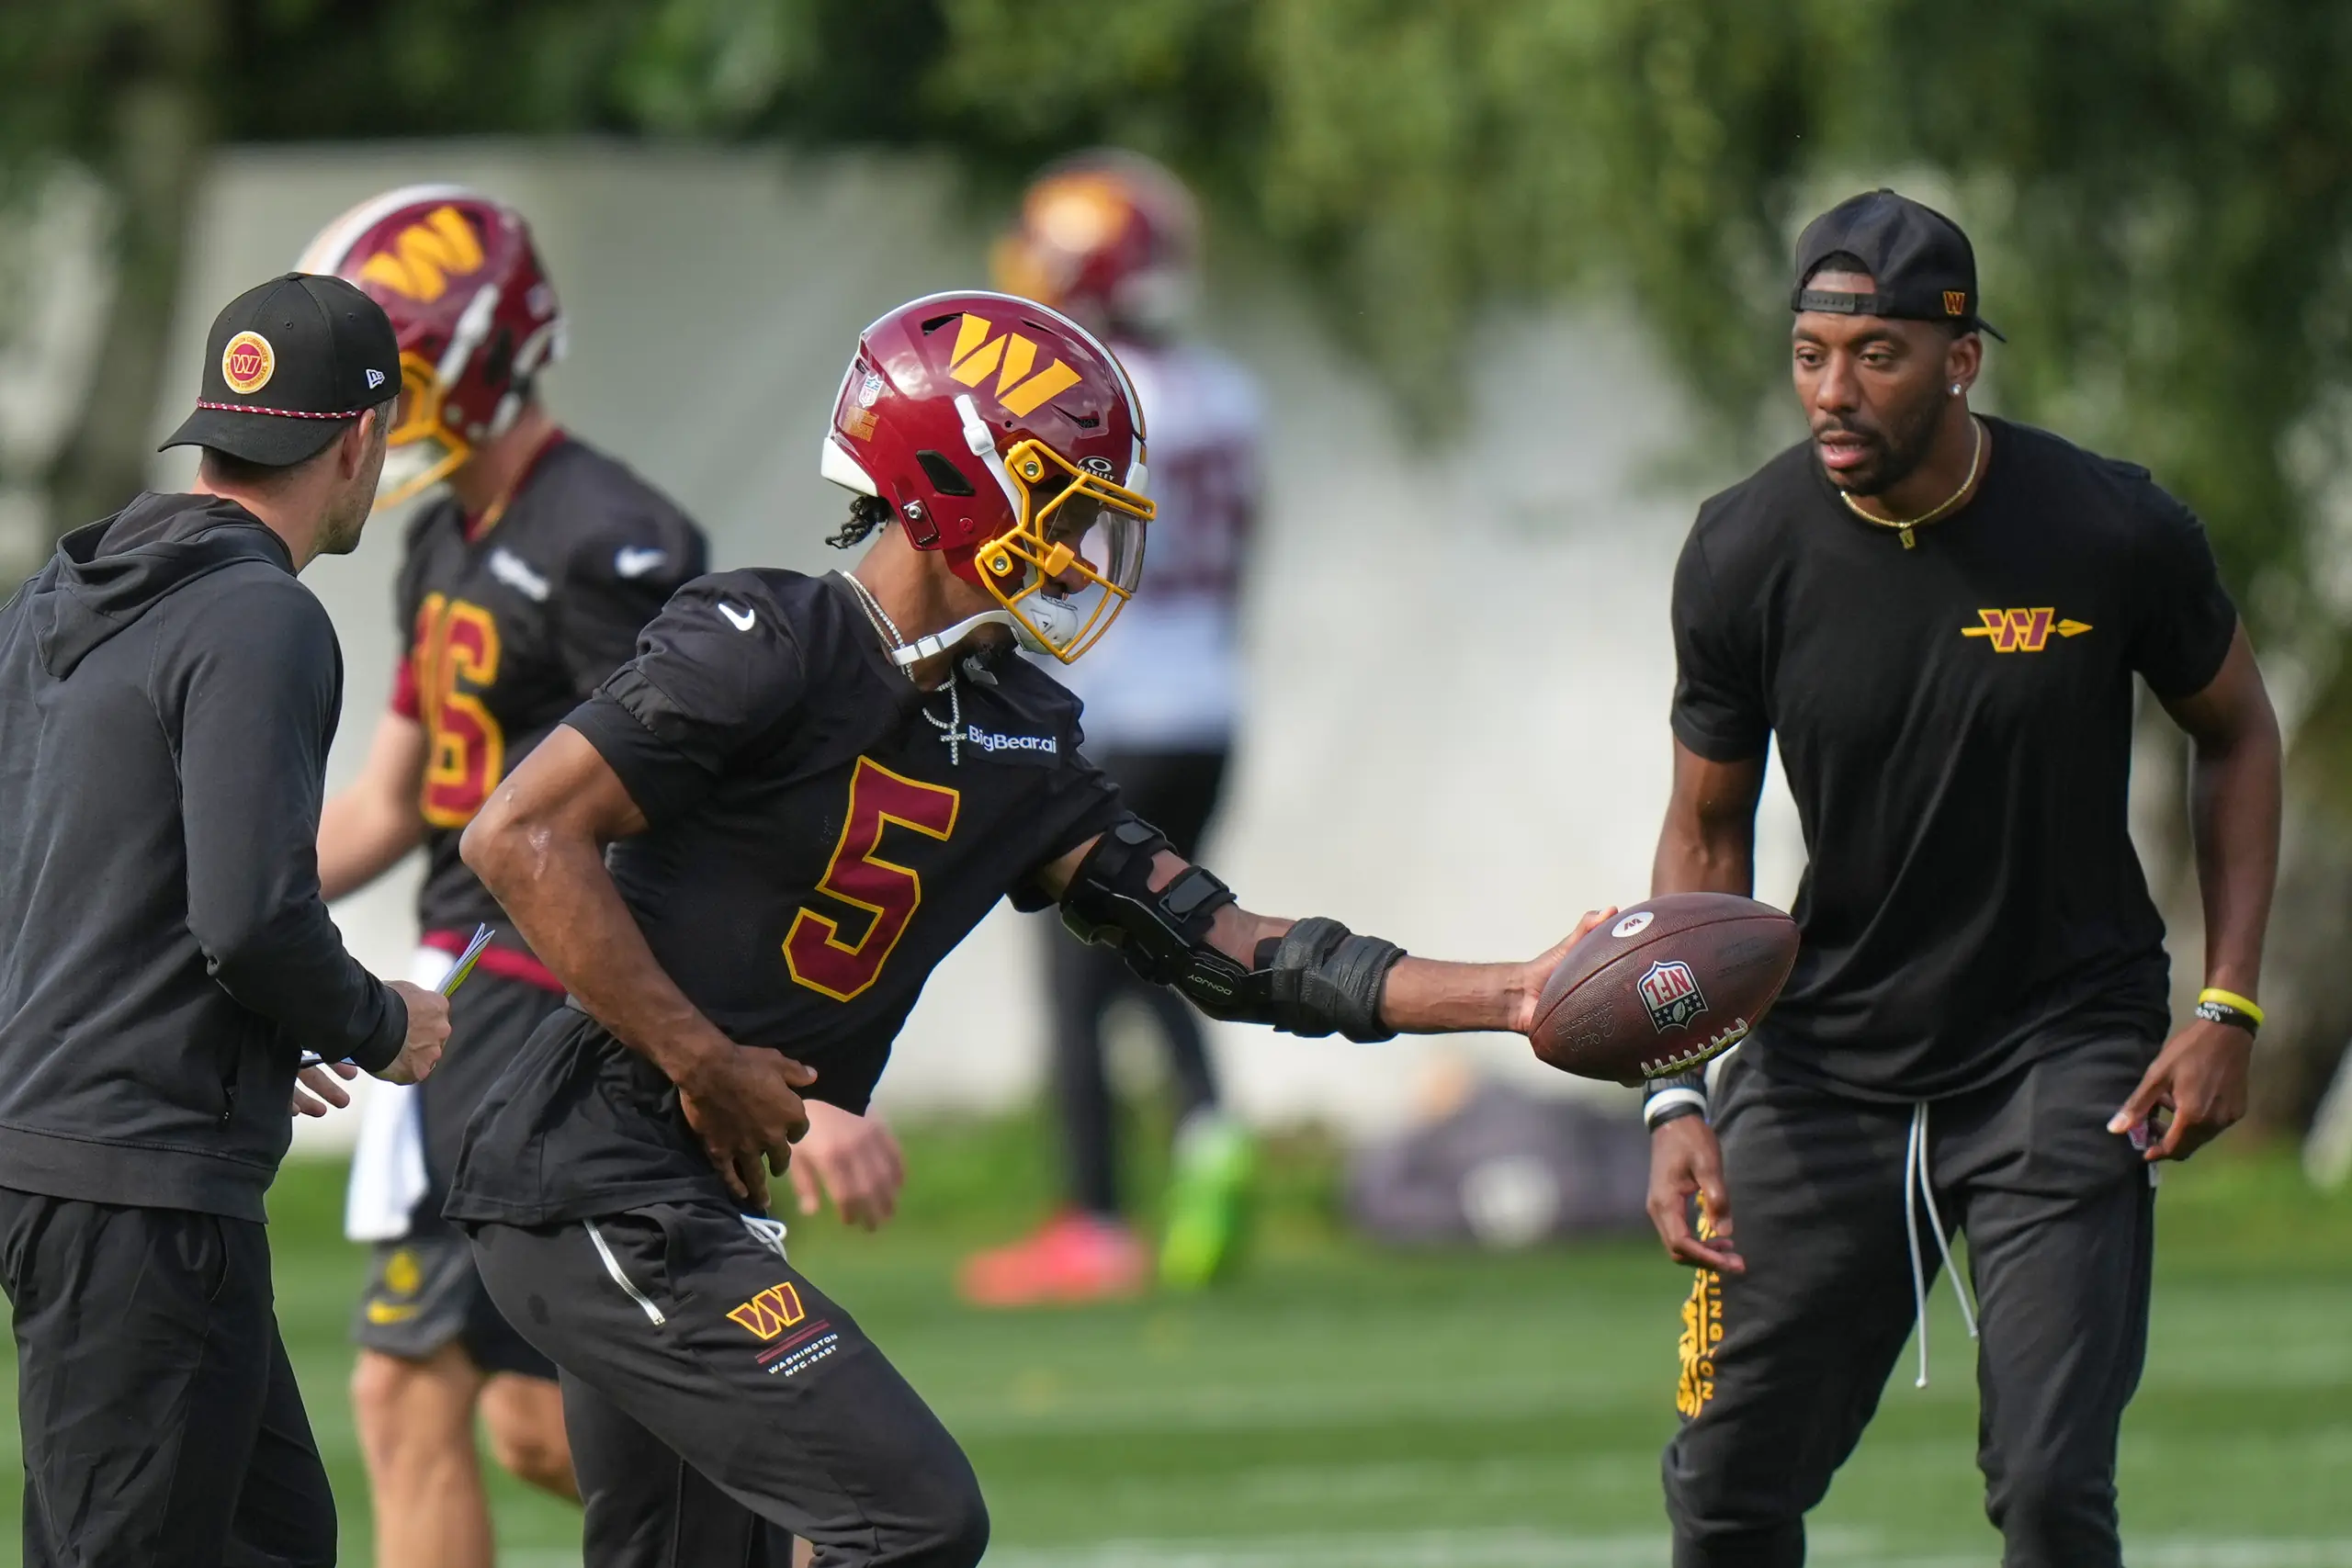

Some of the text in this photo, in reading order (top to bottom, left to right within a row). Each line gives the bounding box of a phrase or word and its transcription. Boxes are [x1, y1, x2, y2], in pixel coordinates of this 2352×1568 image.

[968, 725, 1057, 753] BigBear.ai
[782, 754, 959, 1002] 5
[1187, 974, 1233, 996] DONJOY
[1644, 968, 1692, 1007] NFL
[768, 1333, 839, 1375] WASHINGTON
